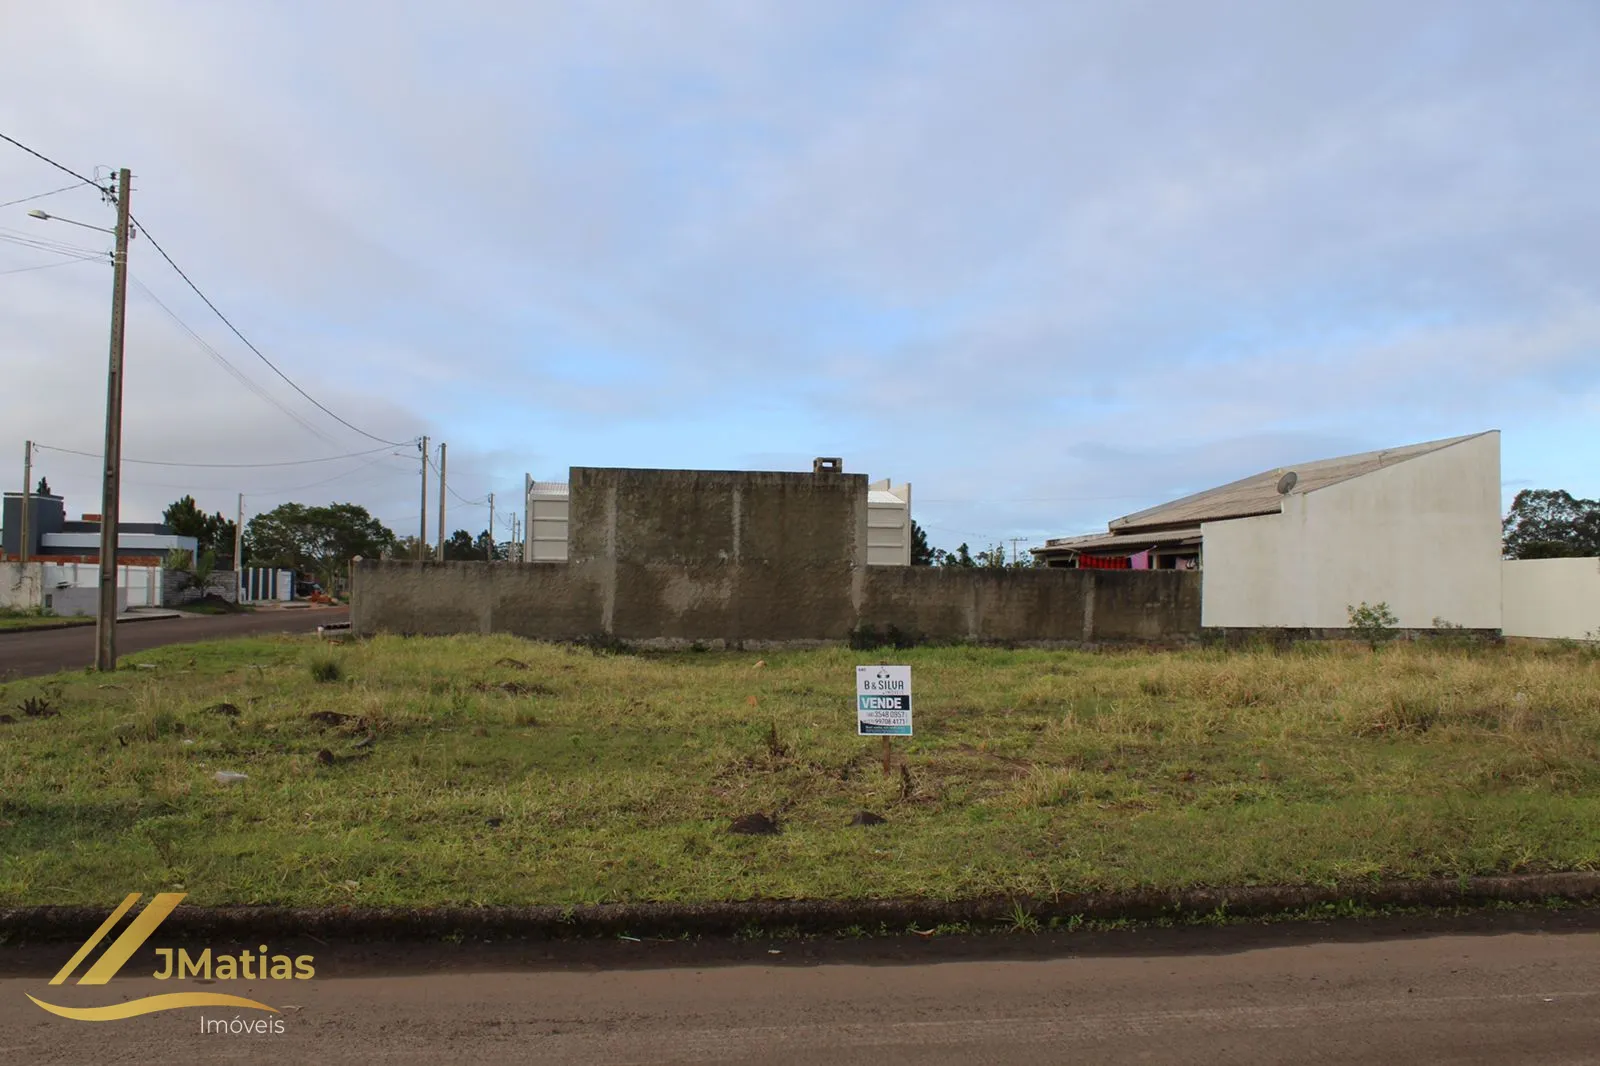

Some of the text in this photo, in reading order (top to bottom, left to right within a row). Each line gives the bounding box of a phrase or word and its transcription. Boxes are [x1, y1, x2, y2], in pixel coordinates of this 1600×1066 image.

[864, 680, 870, 690] B
[878, 680, 904, 690] SILVA
[861, 697, 902, 709] VENDE
